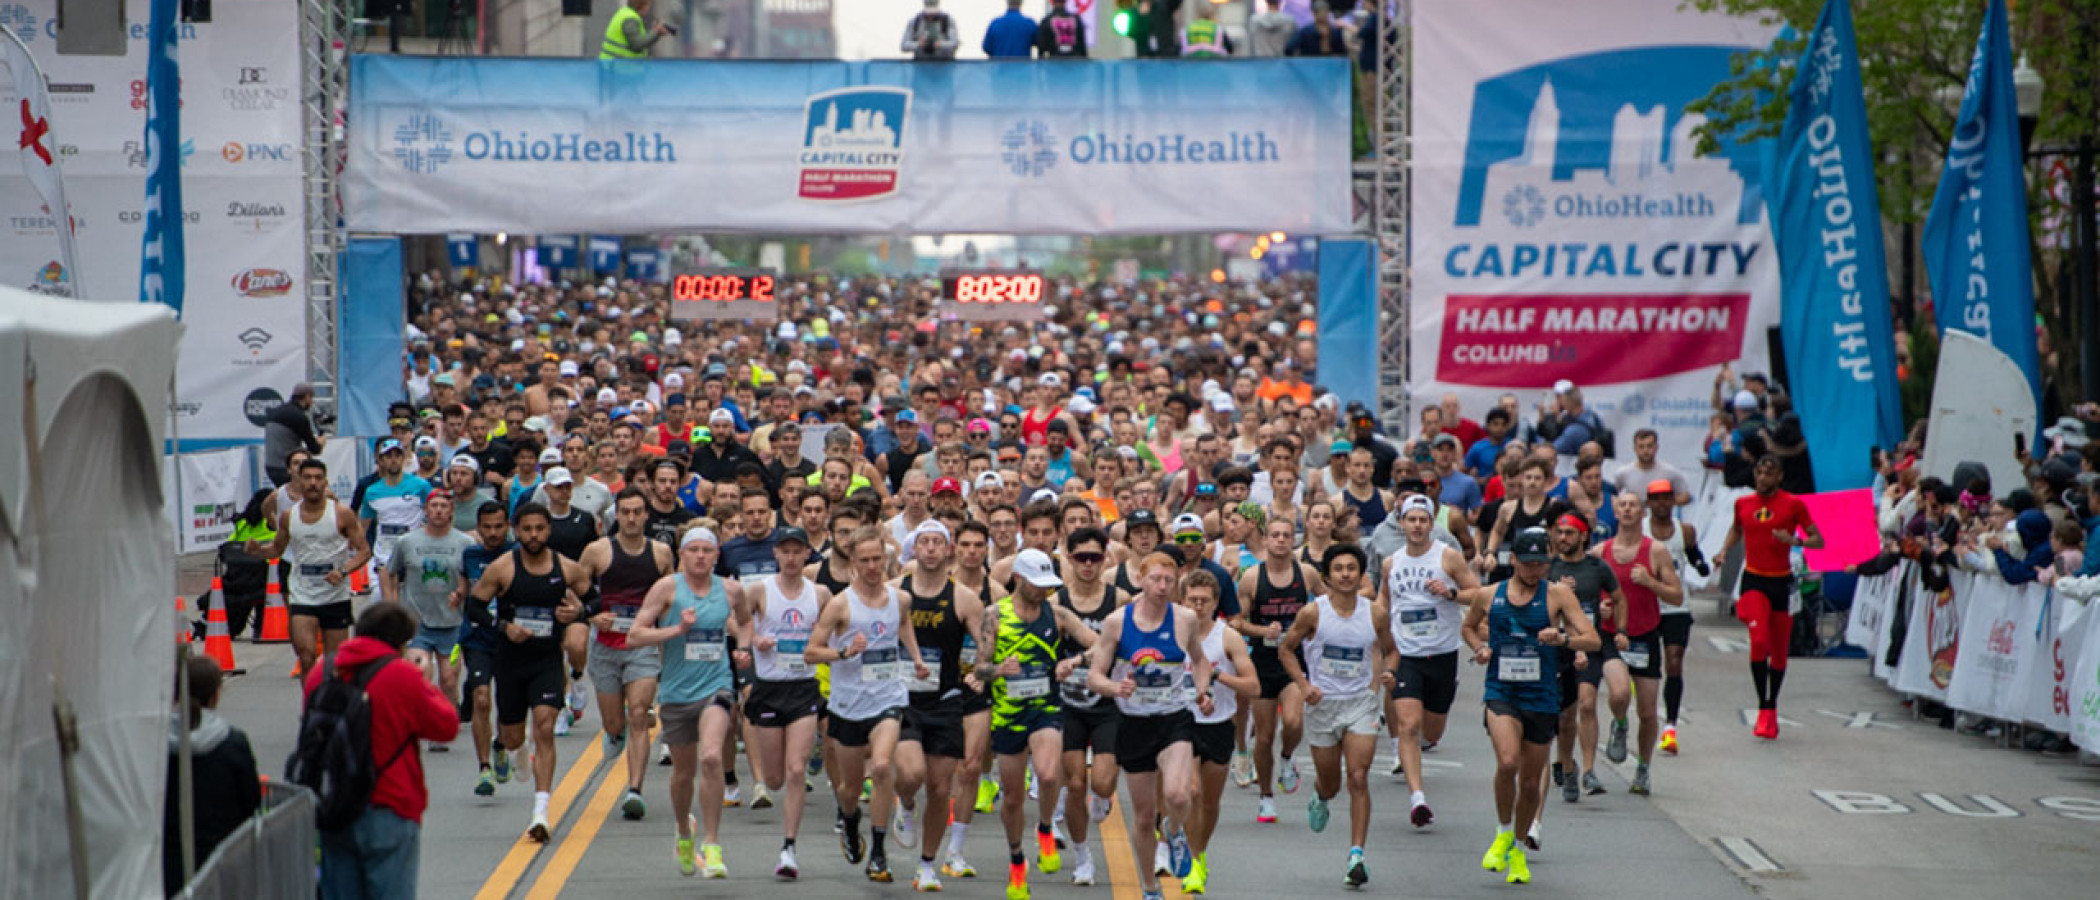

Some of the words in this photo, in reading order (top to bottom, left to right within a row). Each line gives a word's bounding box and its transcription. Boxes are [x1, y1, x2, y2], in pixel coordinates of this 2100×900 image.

[247, 143, 292, 160] PNC
[464, 131, 676, 163] OhioHealth
[801, 152, 863, 164] CAPITAL
[866, 153, 900, 164] CITY
[1069, 131, 1279, 164] OhioHealth
[226, 202, 286, 216] Dillon's
[1554, 194, 1715, 218] OhioHealth
[1445, 244, 1644, 277] CAPITAL
[1652, 242, 1761, 276] CITY
[956, 274, 1042, 302] 8:02:00
[1456, 307, 1537, 332] HALF
[1542, 306, 1731, 332] MARATHON
